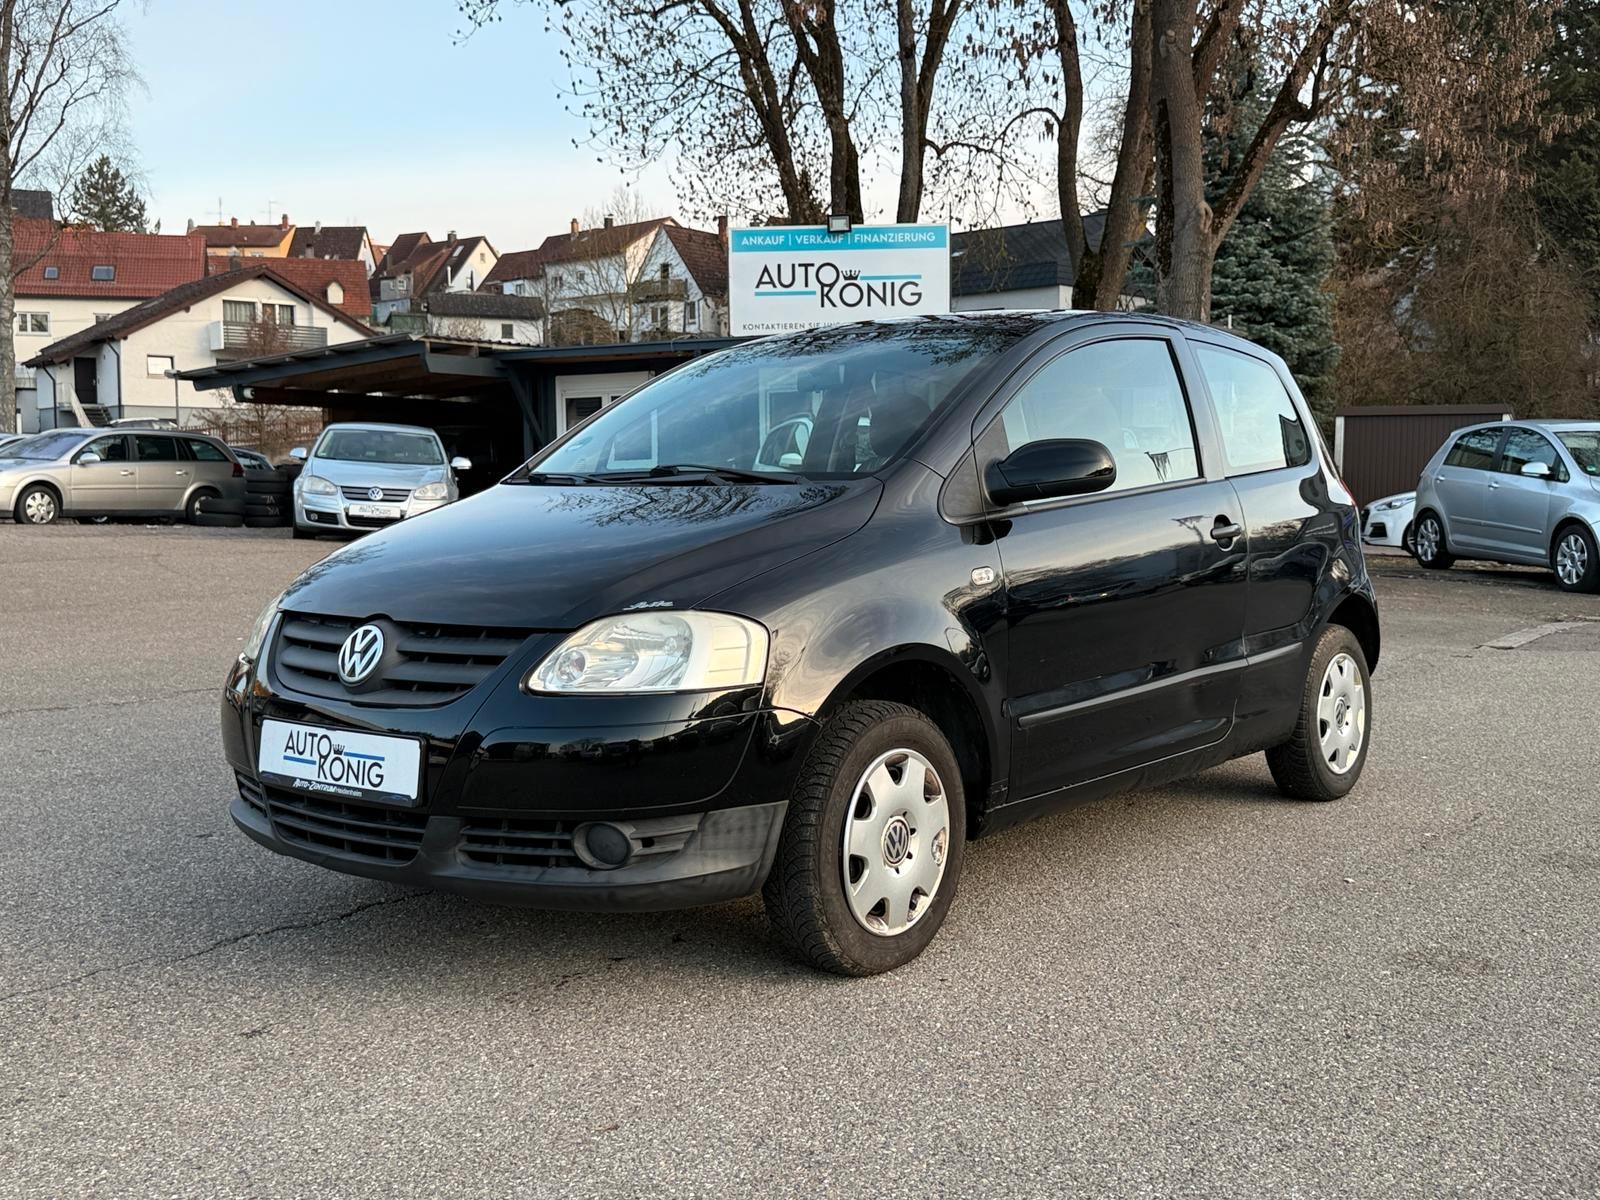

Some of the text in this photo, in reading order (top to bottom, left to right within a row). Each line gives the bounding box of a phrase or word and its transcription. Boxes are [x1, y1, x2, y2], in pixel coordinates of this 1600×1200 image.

[741, 232, 936, 246] ANKAUF VERKAUF FINANZIERUNG
[755, 262, 840, 289] AUTO
[742, 322, 805, 331] KONTAKTIEREN
[338, 624, 384, 684] VW
[284, 729, 332, 759] AUTO
